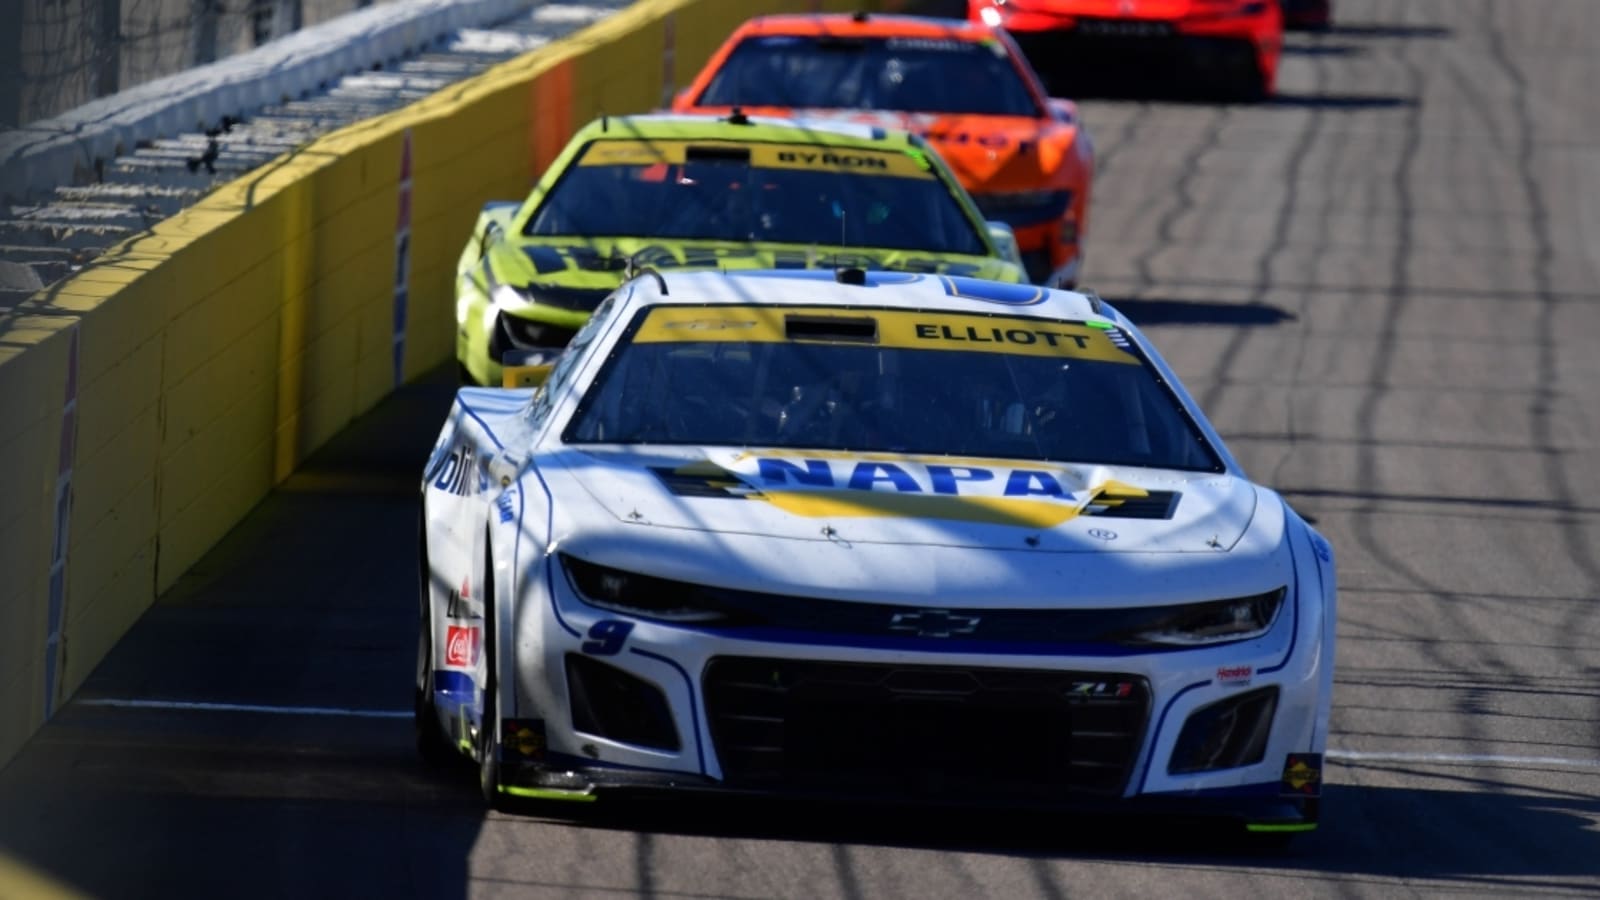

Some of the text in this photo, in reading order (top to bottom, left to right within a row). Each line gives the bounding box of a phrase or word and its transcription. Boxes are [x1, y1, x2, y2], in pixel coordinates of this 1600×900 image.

[777, 151, 888, 169] BYRON
[914, 323, 1091, 349] ELLIOTT
[757, 457, 1077, 501] NAPA
[581, 619, 636, 656] 9
